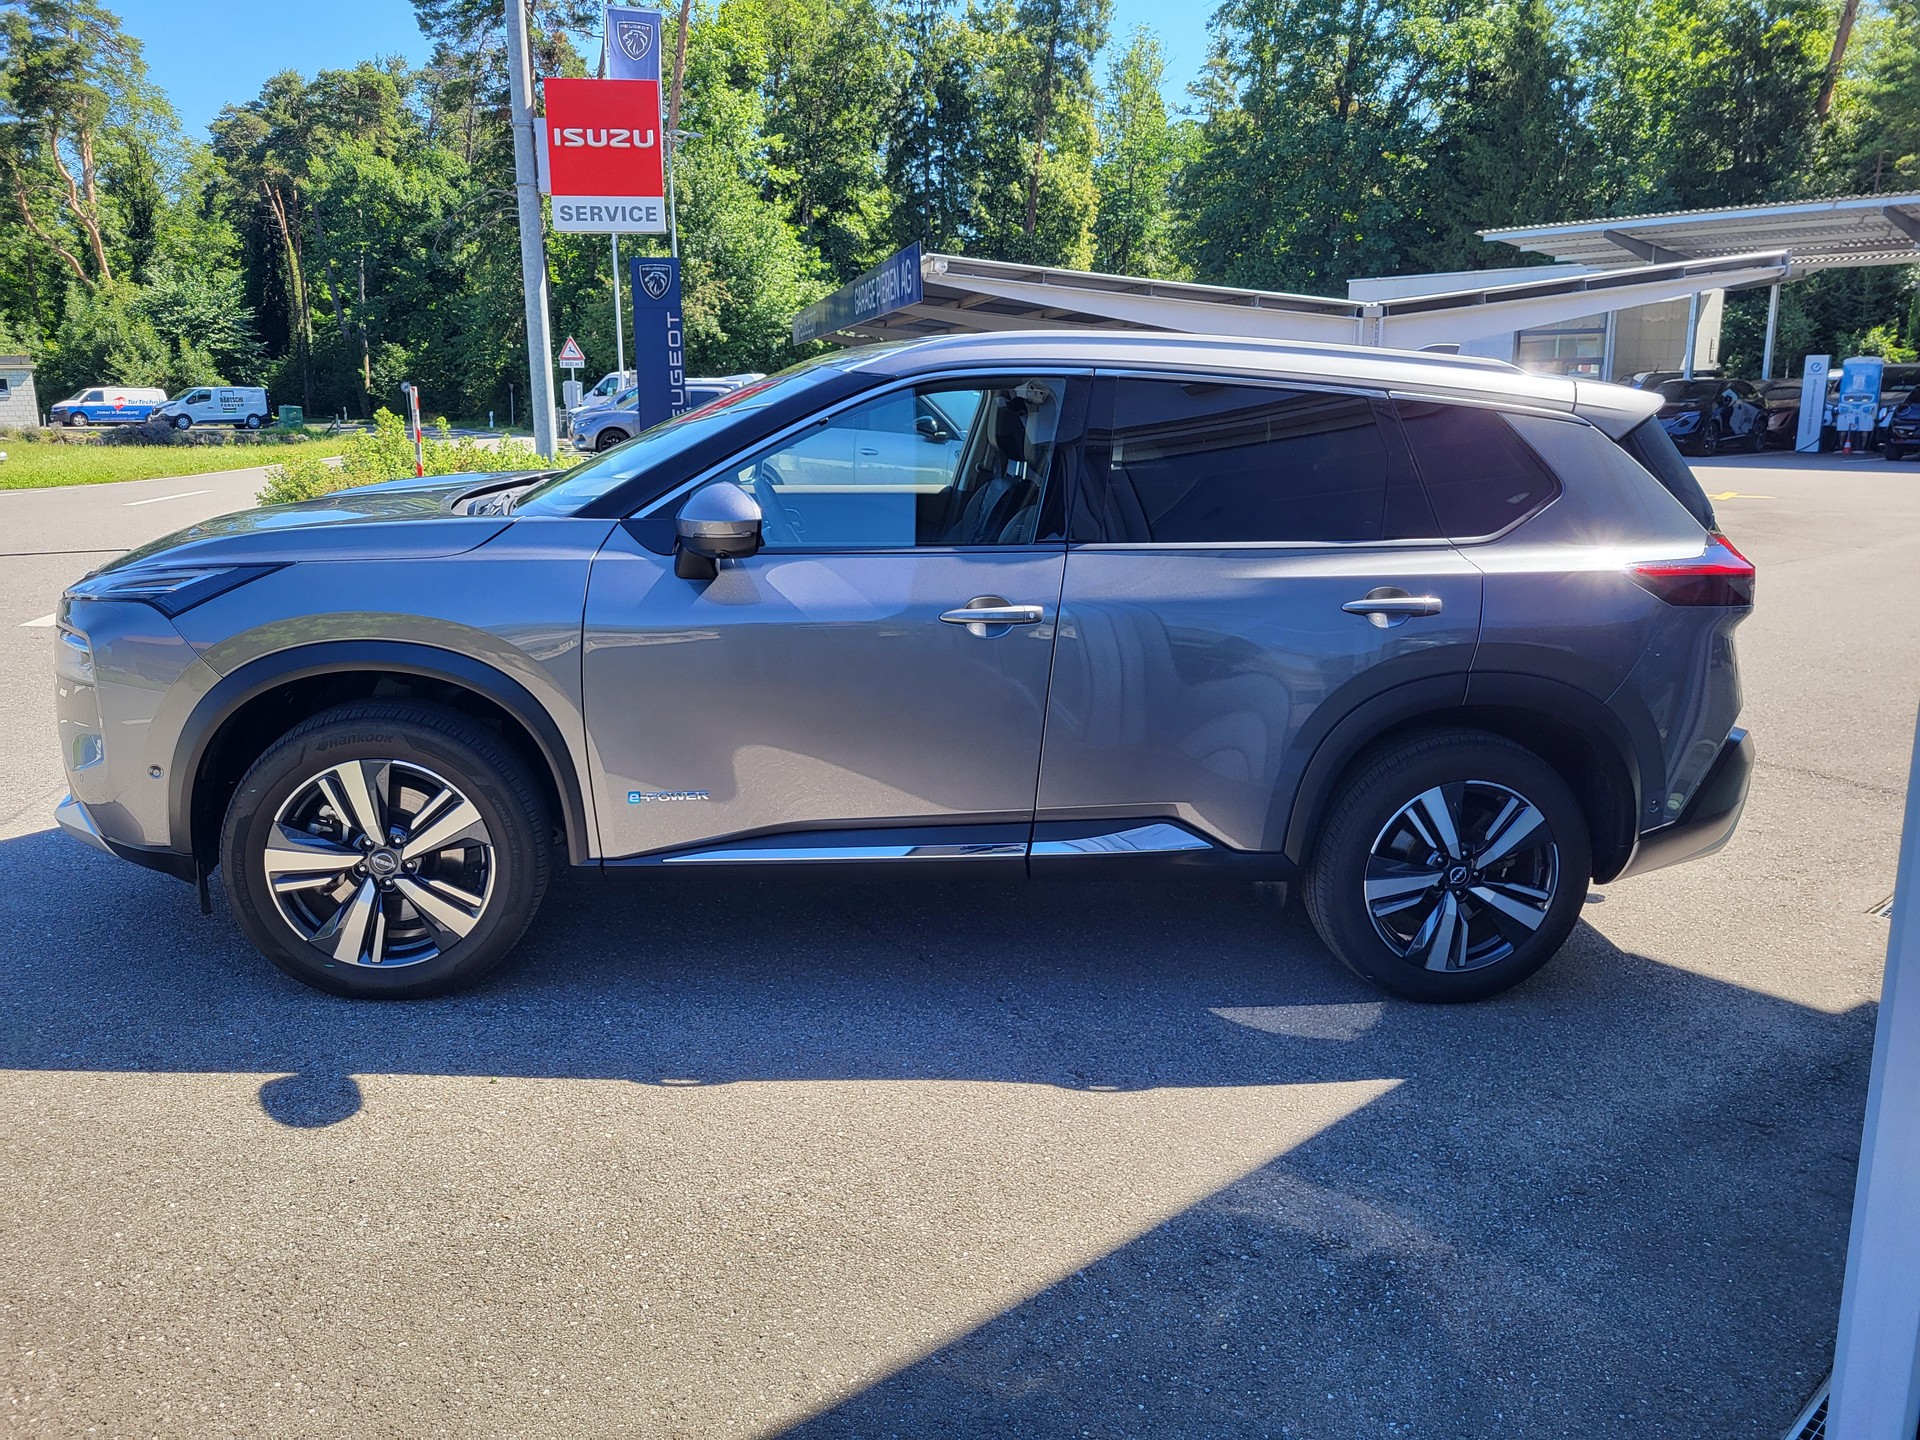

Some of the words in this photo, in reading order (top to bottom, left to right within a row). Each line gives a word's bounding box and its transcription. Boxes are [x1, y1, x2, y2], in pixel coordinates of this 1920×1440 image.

[553, 127, 654, 148] ISUZU
[559, 205, 658, 222] SERVICE
[854, 278, 876, 315] GARAGE
[901, 258, 912, 297] AG
[666, 311, 685, 418] EUGEOT
[628, 790, 710, 804] e-POWER
